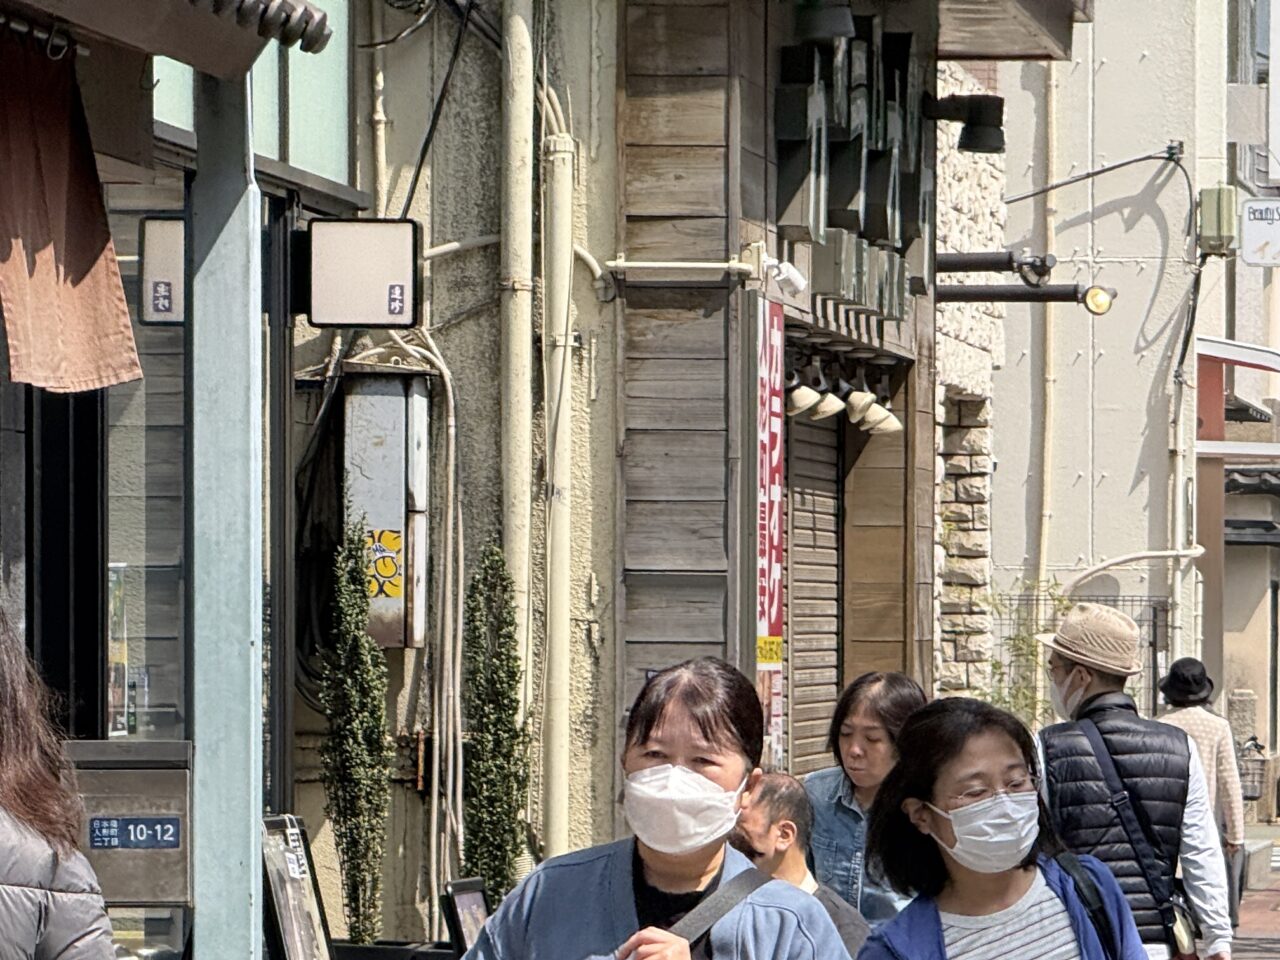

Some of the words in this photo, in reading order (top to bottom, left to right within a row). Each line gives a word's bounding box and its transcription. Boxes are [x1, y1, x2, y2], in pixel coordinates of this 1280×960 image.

[769, 316, 783, 624] カラオケ
[127, 823, 175, 841] 10-12
